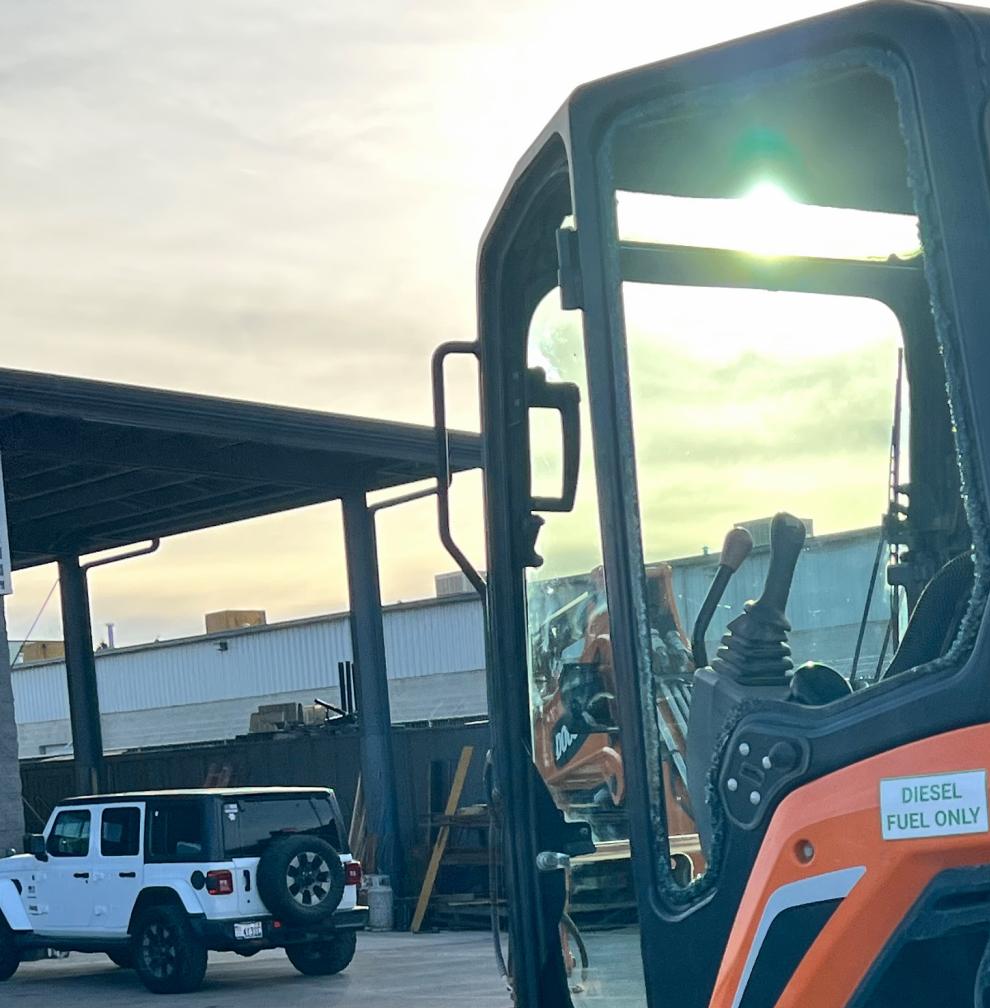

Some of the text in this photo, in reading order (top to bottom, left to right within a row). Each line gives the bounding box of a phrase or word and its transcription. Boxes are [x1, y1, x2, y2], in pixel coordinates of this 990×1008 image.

[901, 782, 962, 804] DIESEL
[886, 806, 981, 831] FUEL ONLY
